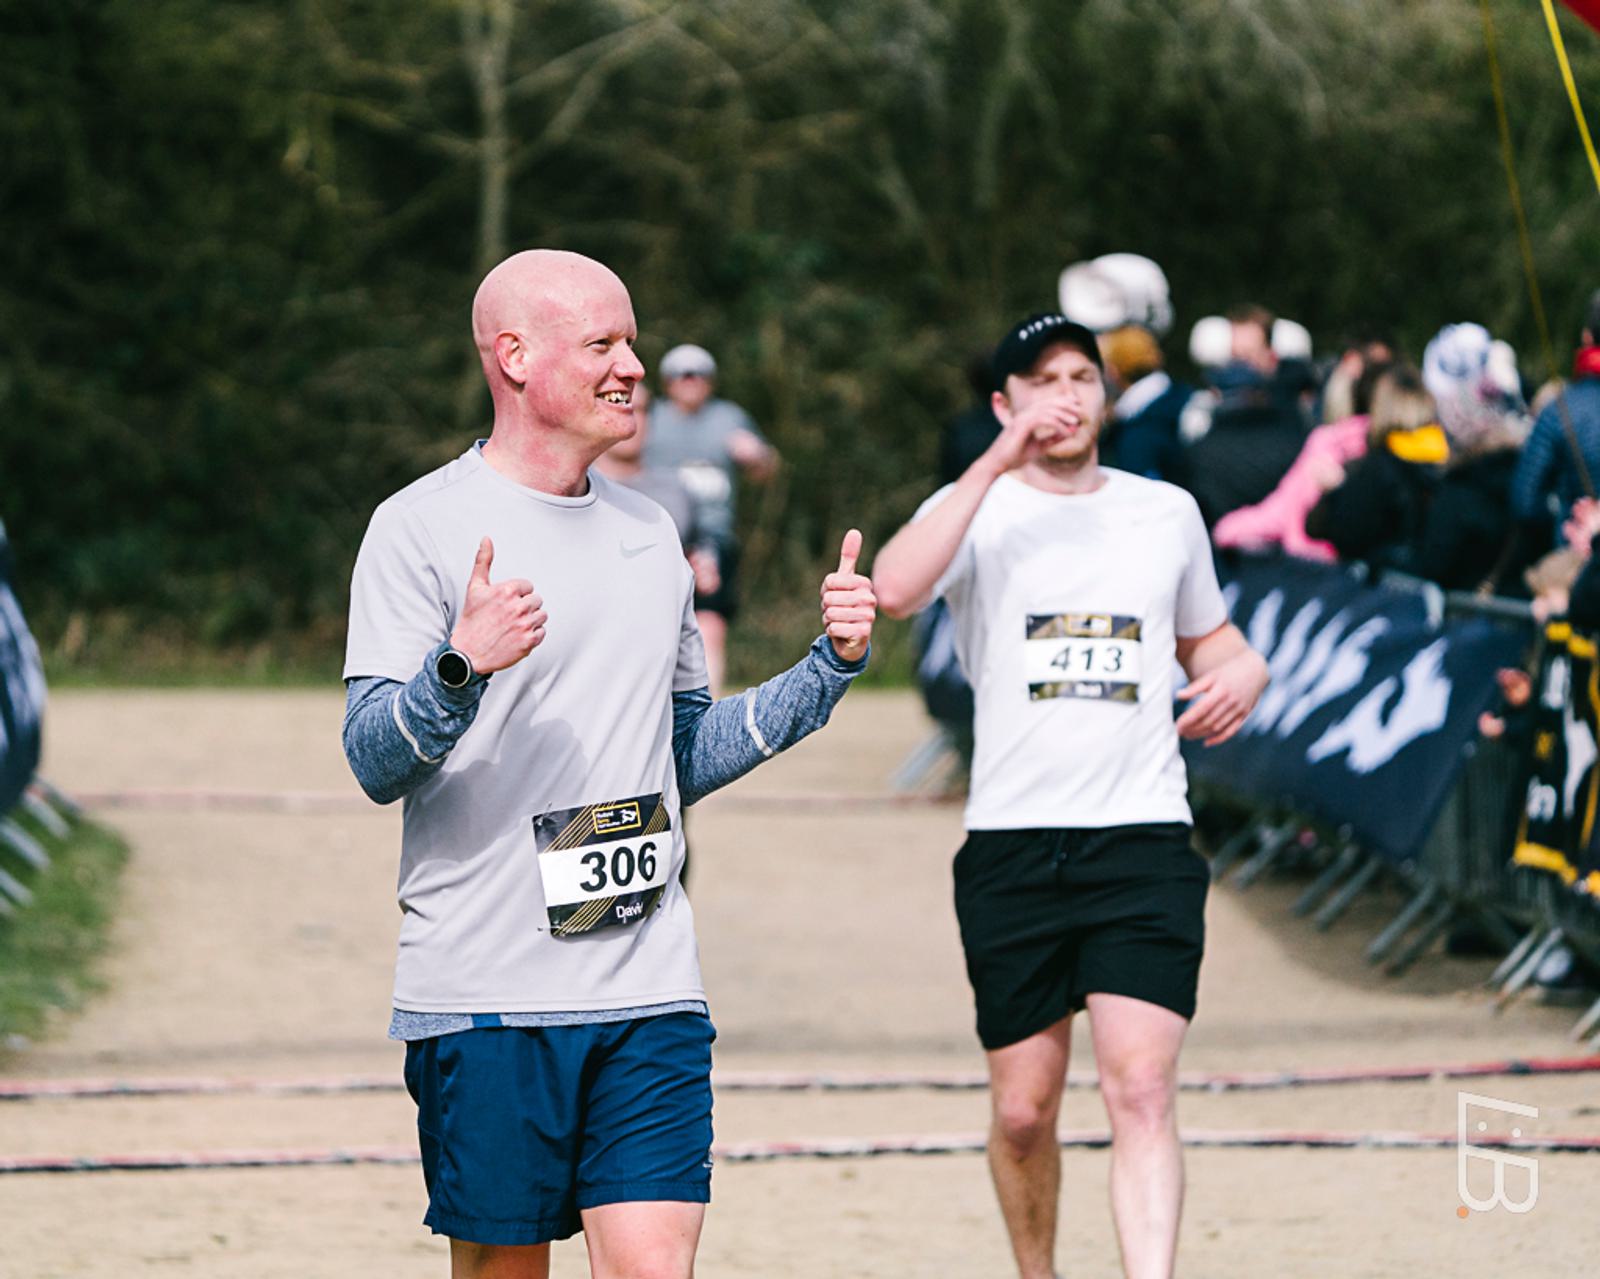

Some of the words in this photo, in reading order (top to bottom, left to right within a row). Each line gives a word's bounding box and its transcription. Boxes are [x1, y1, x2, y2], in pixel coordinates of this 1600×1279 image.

[1050, 646, 1123, 672] 413
[579, 841, 657, 893] 306
[615, 902, 644, 919] Davi
